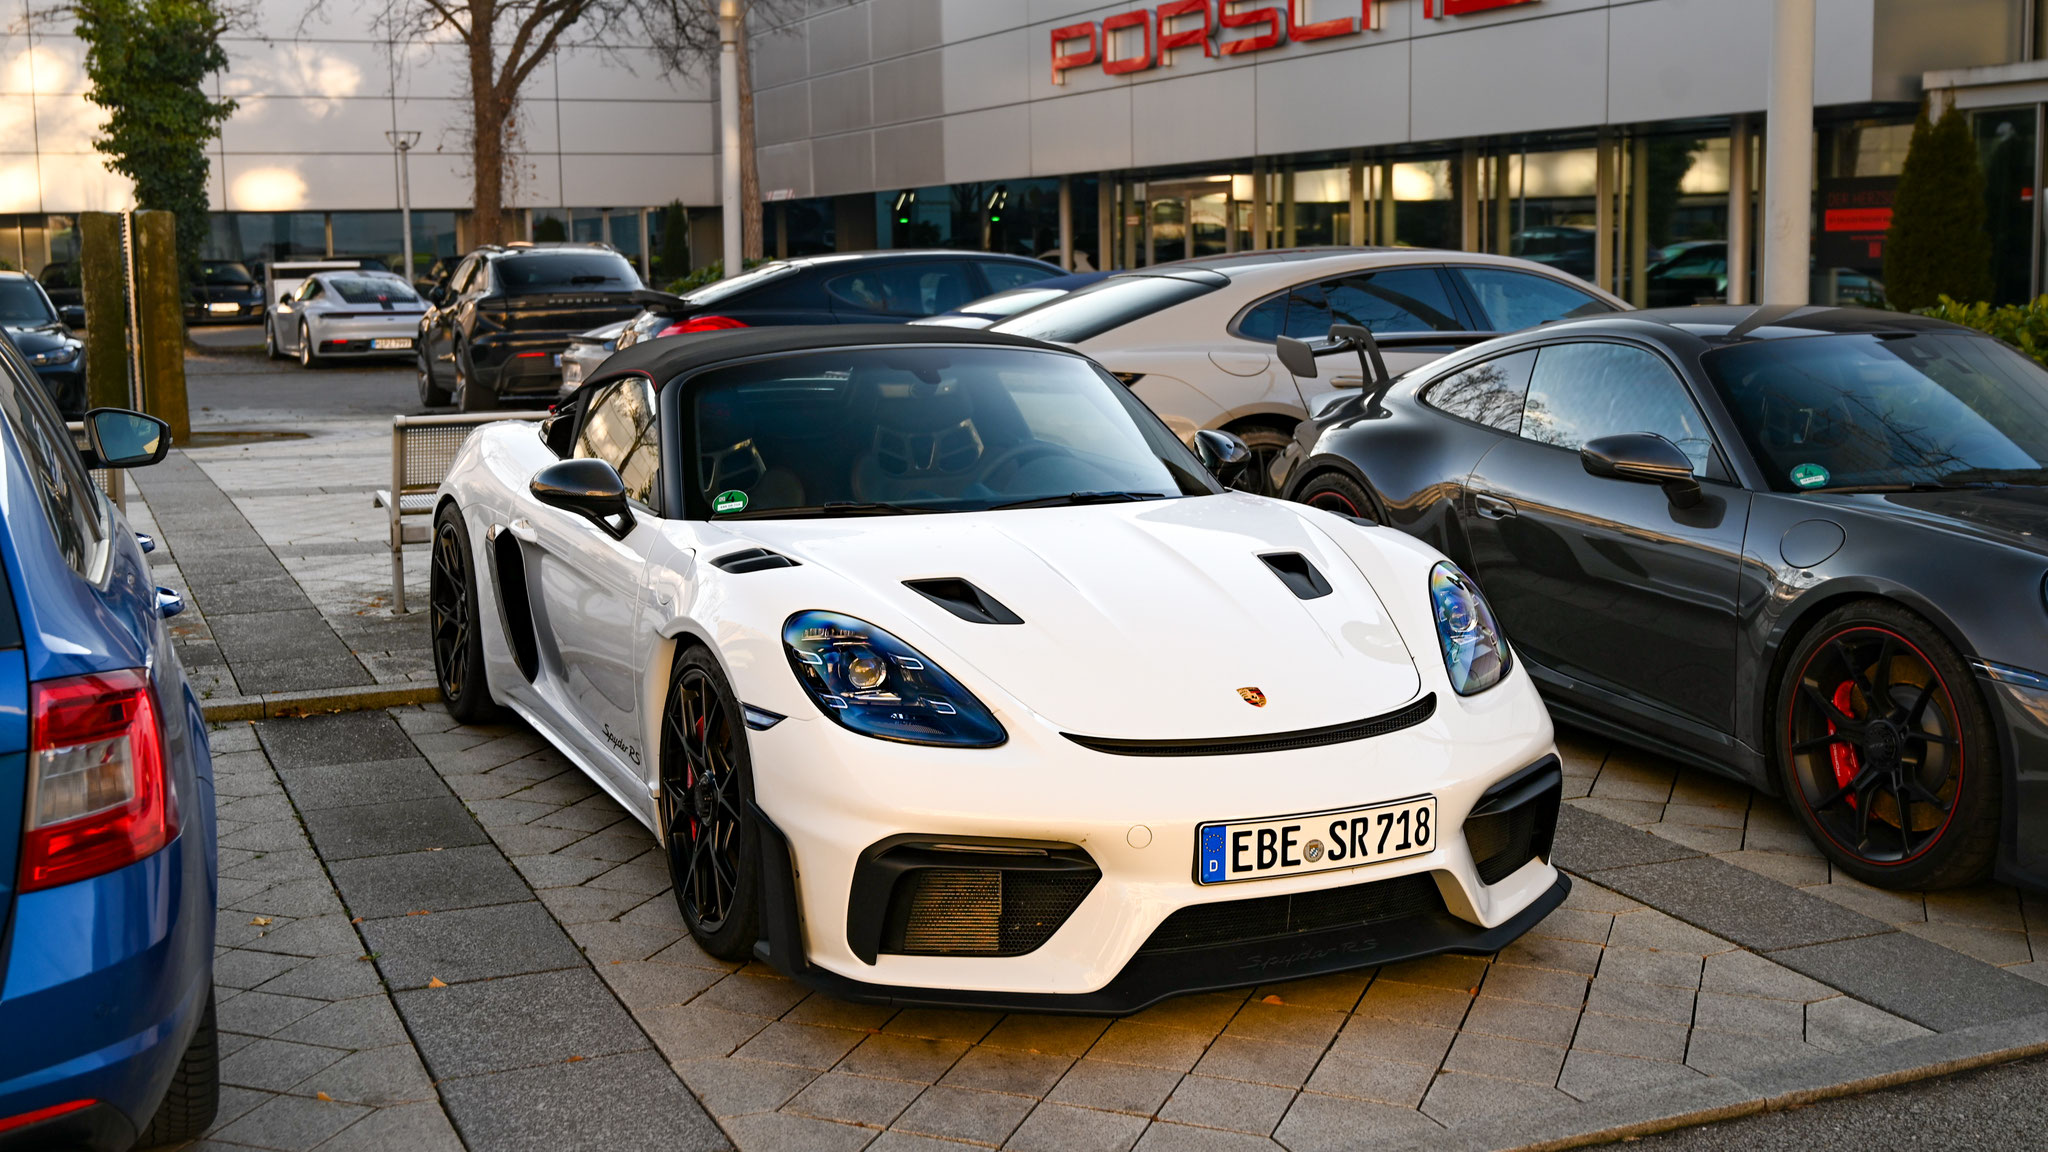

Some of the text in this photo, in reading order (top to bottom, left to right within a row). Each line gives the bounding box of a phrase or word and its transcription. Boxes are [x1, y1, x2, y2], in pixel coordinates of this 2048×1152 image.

[1051, 0, 1540, 85] PORSC
[726, 491, 735, 502] 4
[602, 723, 641, 766] Spyder RS
[1209, 806, 1431, 873] D EBE SR 718
